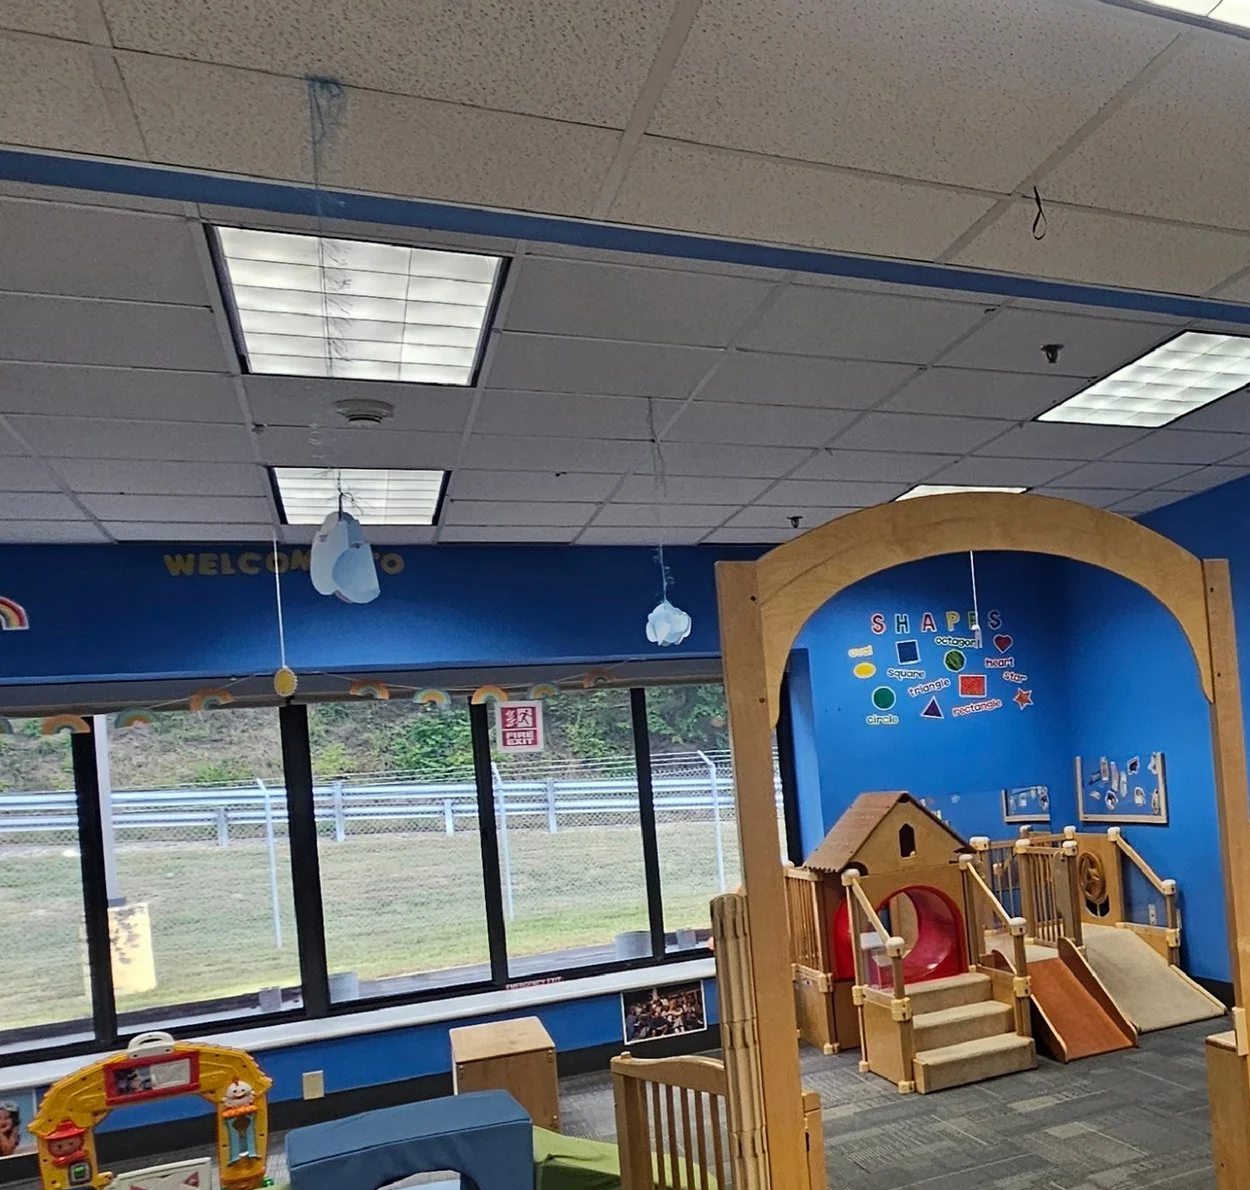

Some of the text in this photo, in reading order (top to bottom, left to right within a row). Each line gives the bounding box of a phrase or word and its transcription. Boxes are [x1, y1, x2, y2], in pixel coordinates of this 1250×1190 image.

[163, 551, 312, 576] WELCOM
[870, 609, 1002, 635] SHAPES
[984, 657, 1015, 669] heart
[887, 668, 926, 681] square
[1002, 670, 1028, 684] star
[908, 677, 951, 698] triangle
[951, 697, 1003, 717] rectangle
[866, 713, 899, 725] circle
[506, 731, 535, 739] FIRE
[506, 738, 534, 746] EXIT
